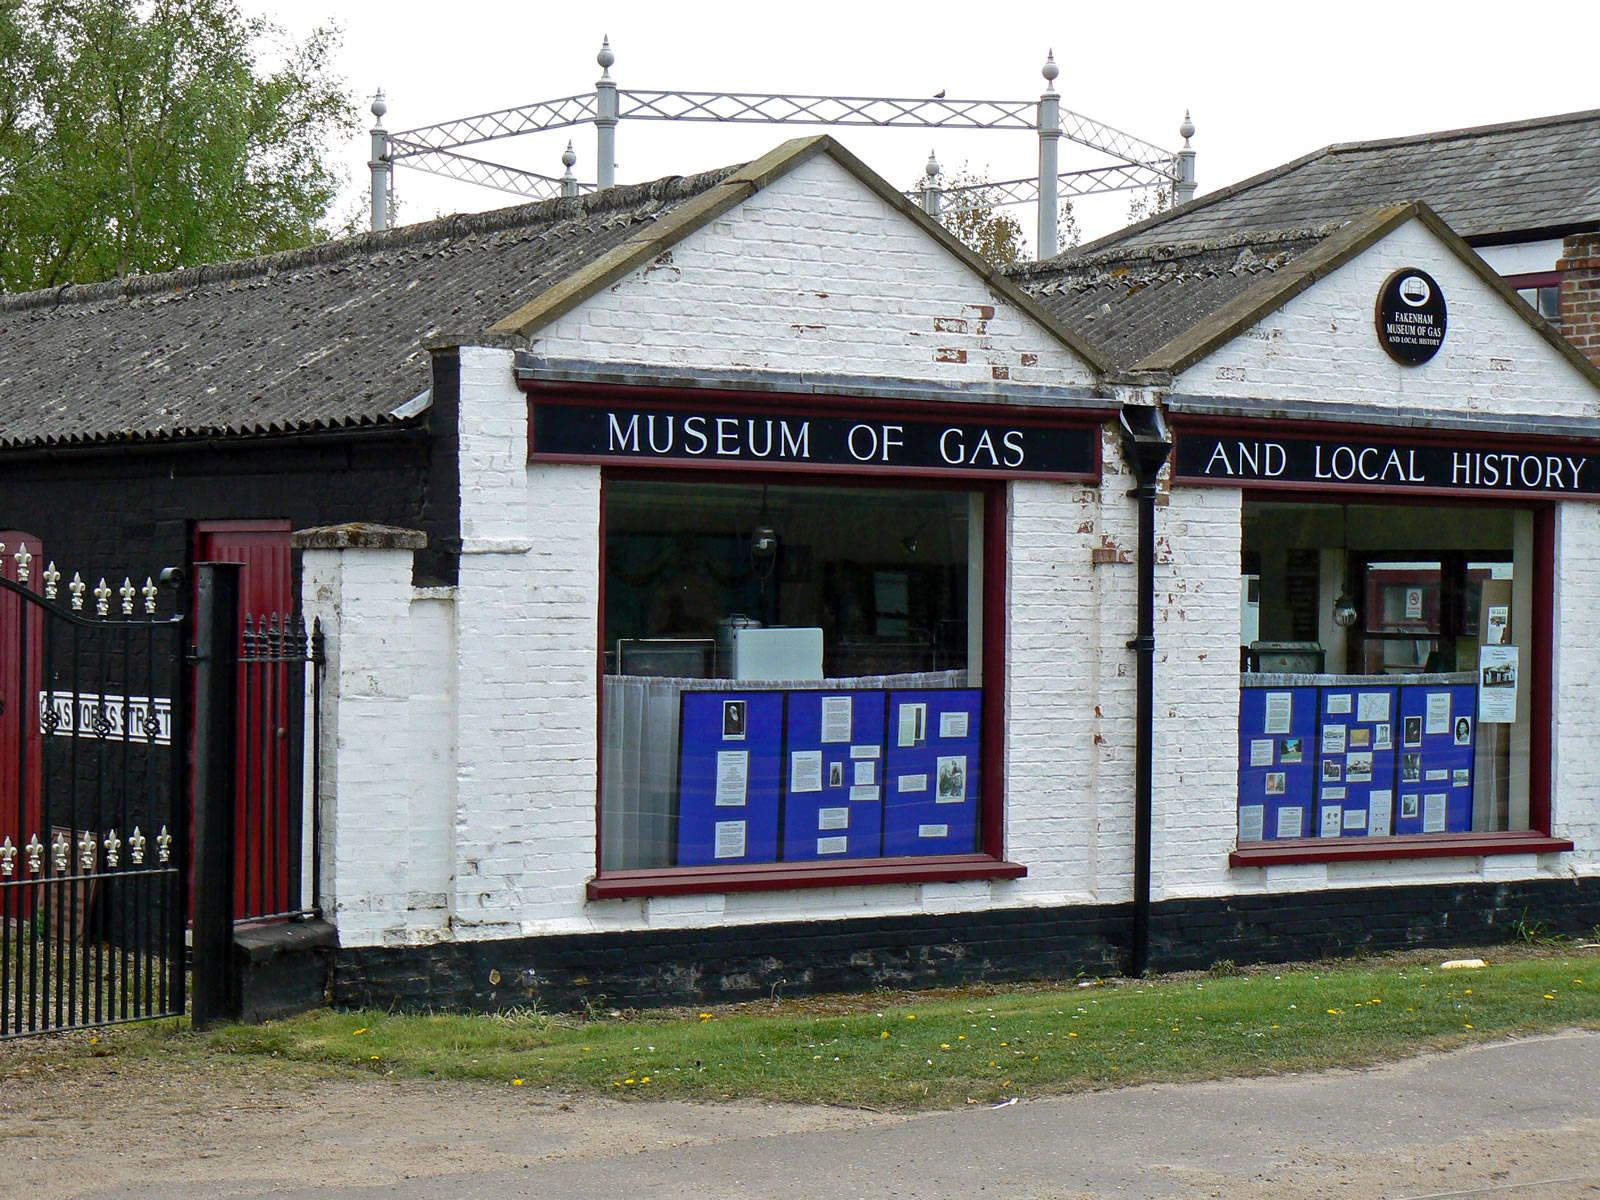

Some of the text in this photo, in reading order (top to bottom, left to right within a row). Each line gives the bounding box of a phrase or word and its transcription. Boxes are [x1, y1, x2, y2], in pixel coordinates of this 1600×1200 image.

[1387, 323, 1441, 337] MUSEUM OF GAS
[1395, 311, 1433, 324] FAKENHAM
[607, 412, 1026, 468] MUSEUM OF GAS
[1204, 440, 1588, 489] AND LOCAL HISTORY
